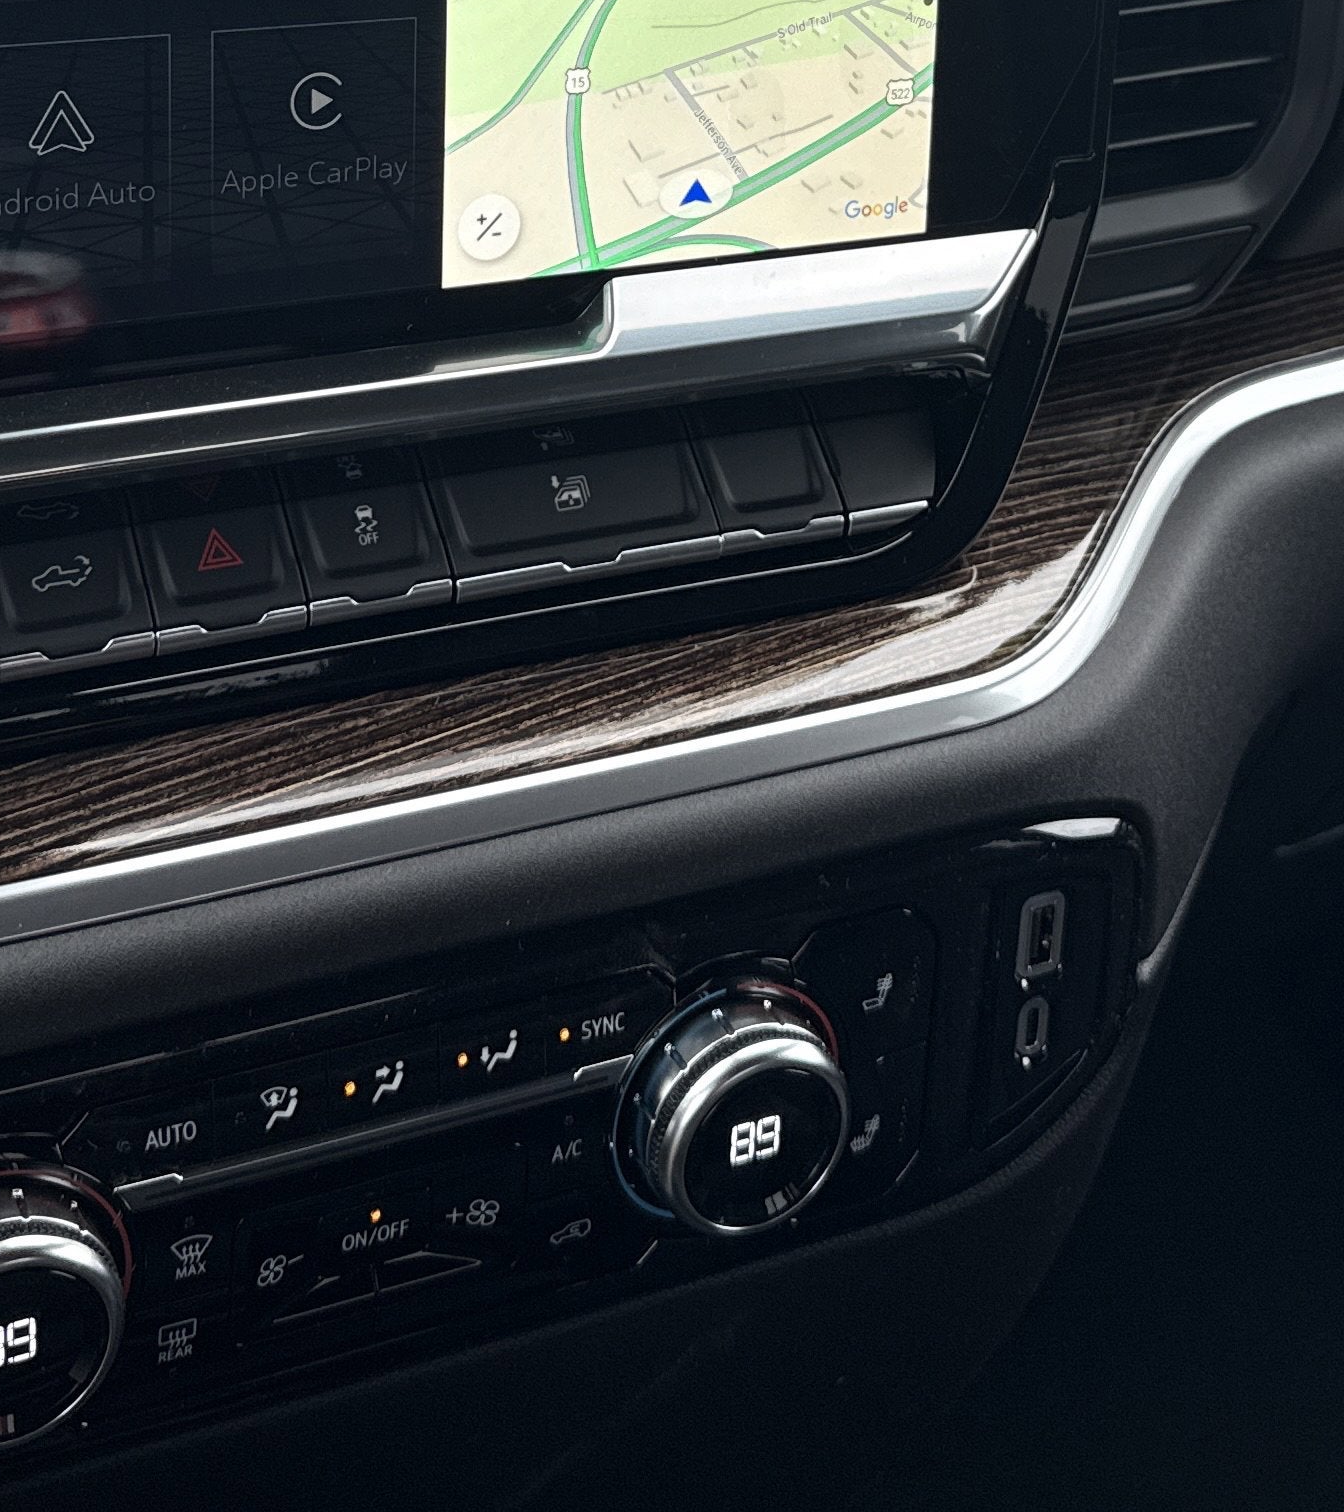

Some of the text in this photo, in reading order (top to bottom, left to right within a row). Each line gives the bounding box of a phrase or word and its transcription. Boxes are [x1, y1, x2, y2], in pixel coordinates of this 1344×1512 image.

[777, 12, 833, 39] S Old Trail
[571, 77, 585, 88] 15
[890, 88, 911, 100] 522
[694, 109, 742, 175] Jefferson Ave
[220, 154, 409, 199] Apple CarPlay
[87, 182, 157, 208] Auto
[844, 196, 909, 219] Google
[358, 531, 379, 546] OFF
[581, 1012, 626, 1041] SYNC
[145, 1120, 197, 1150] AUTO
[729, 1114, 781, 1166] 89
[552, 1138, 582, 1162] A/C
[341, 1218, 410, 1252] ON/OFF
[175, 1260, 207, 1280] MAX
[158, 1344, 193, 1364] REAR
